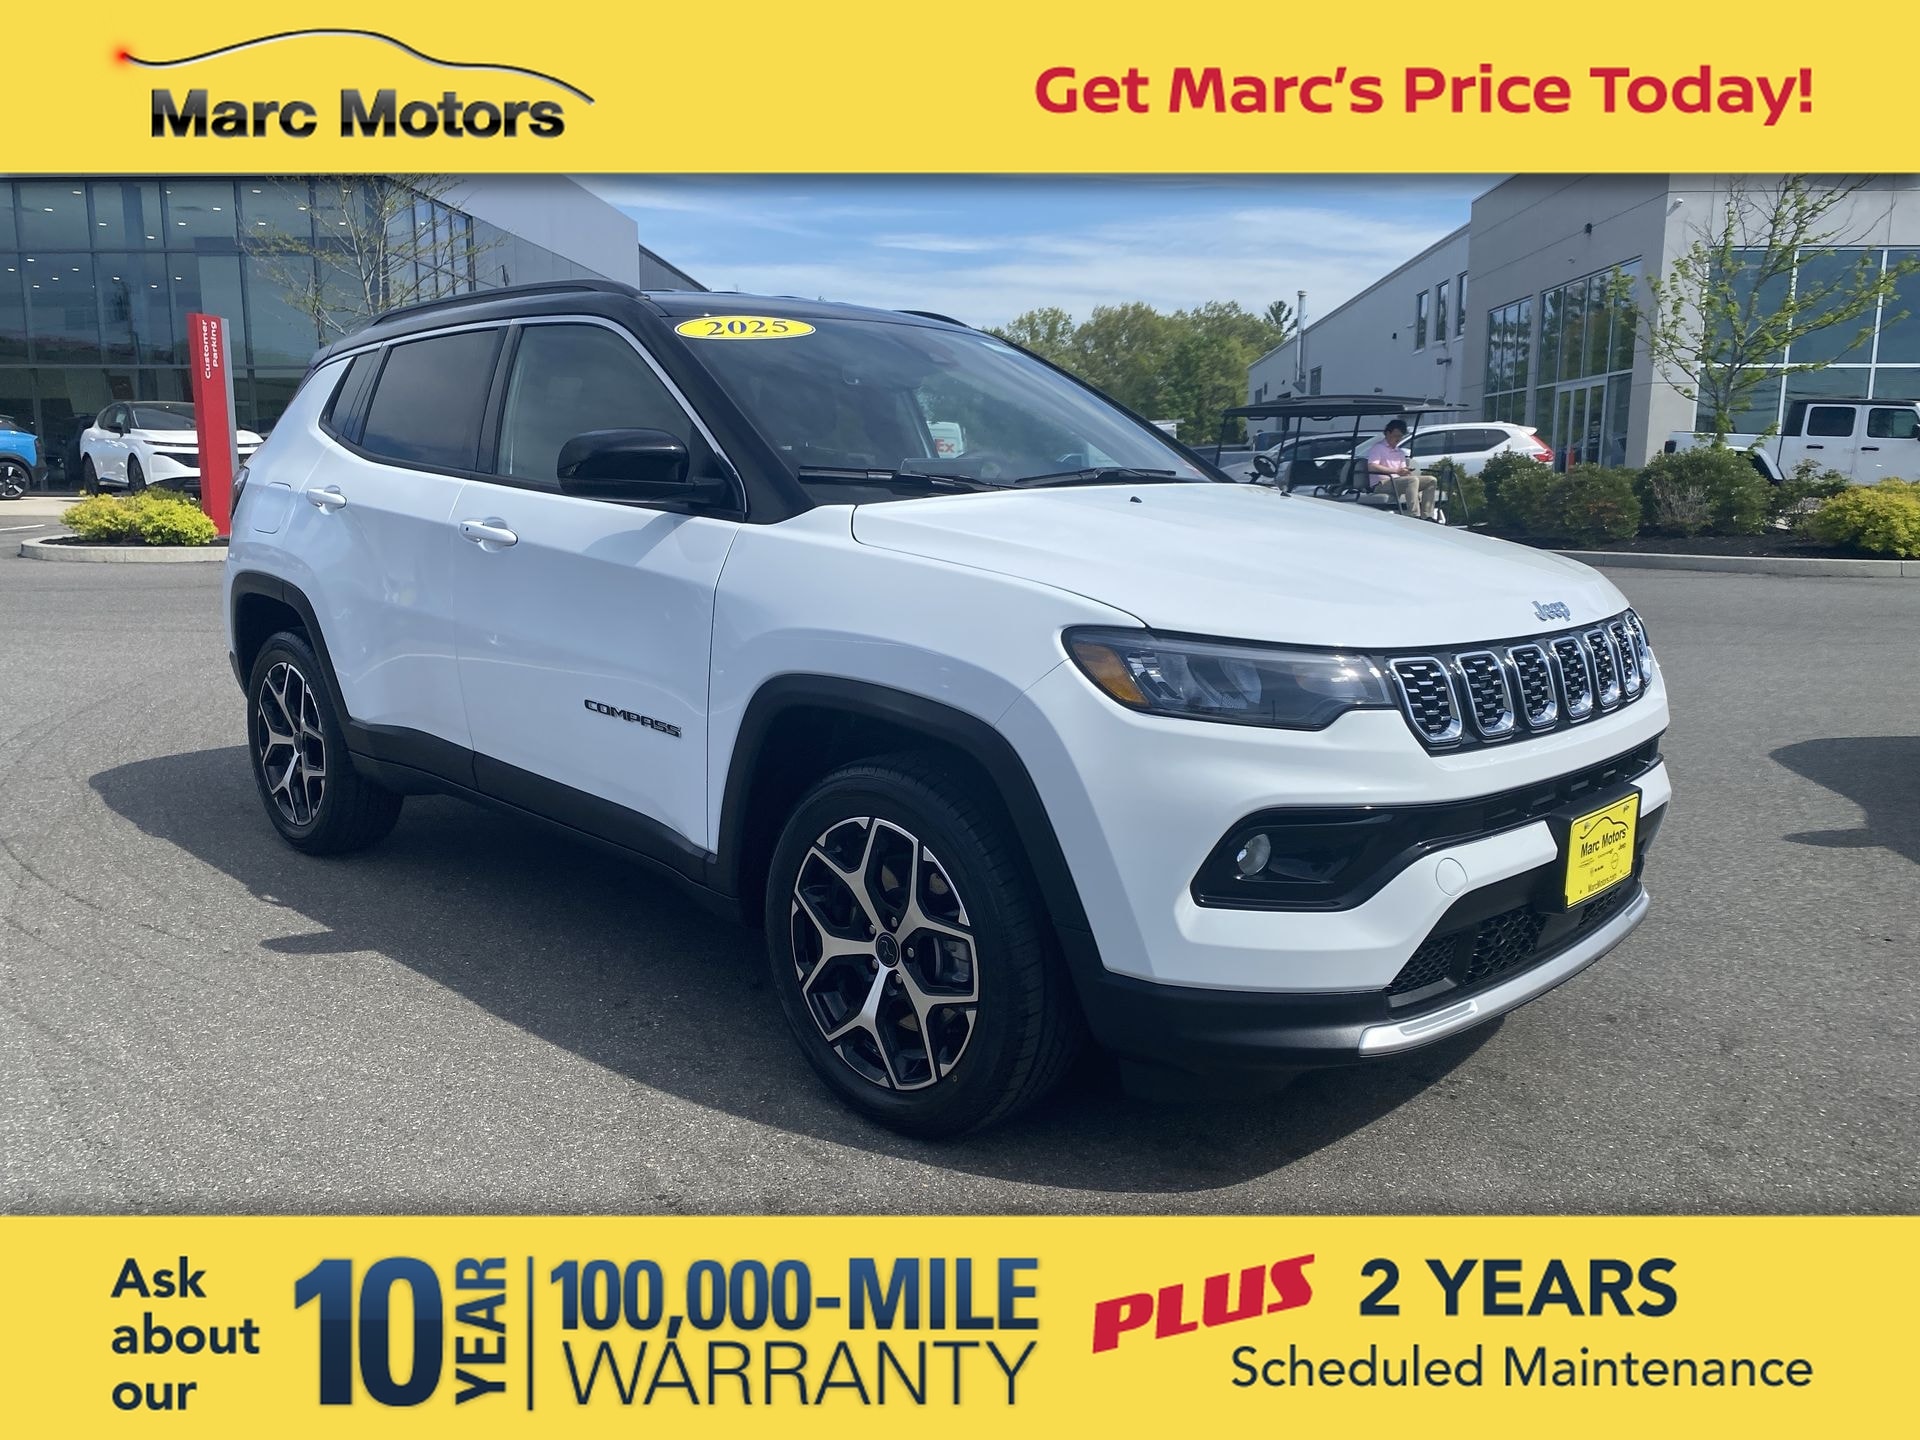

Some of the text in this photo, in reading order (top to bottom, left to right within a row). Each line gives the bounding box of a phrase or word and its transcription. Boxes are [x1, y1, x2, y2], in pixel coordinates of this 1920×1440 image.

[211, 321, 219, 367] Parking
[705, 320, 788, 336] 2025
[202, 319, 211, 379] Customer
[1532, 600, 1571, 622] Jeep
[584, 699, 681, 738] COMPASS
[1580, 840, 1600, 858] Marc
[1601, 828, 1626, 848] Motors
